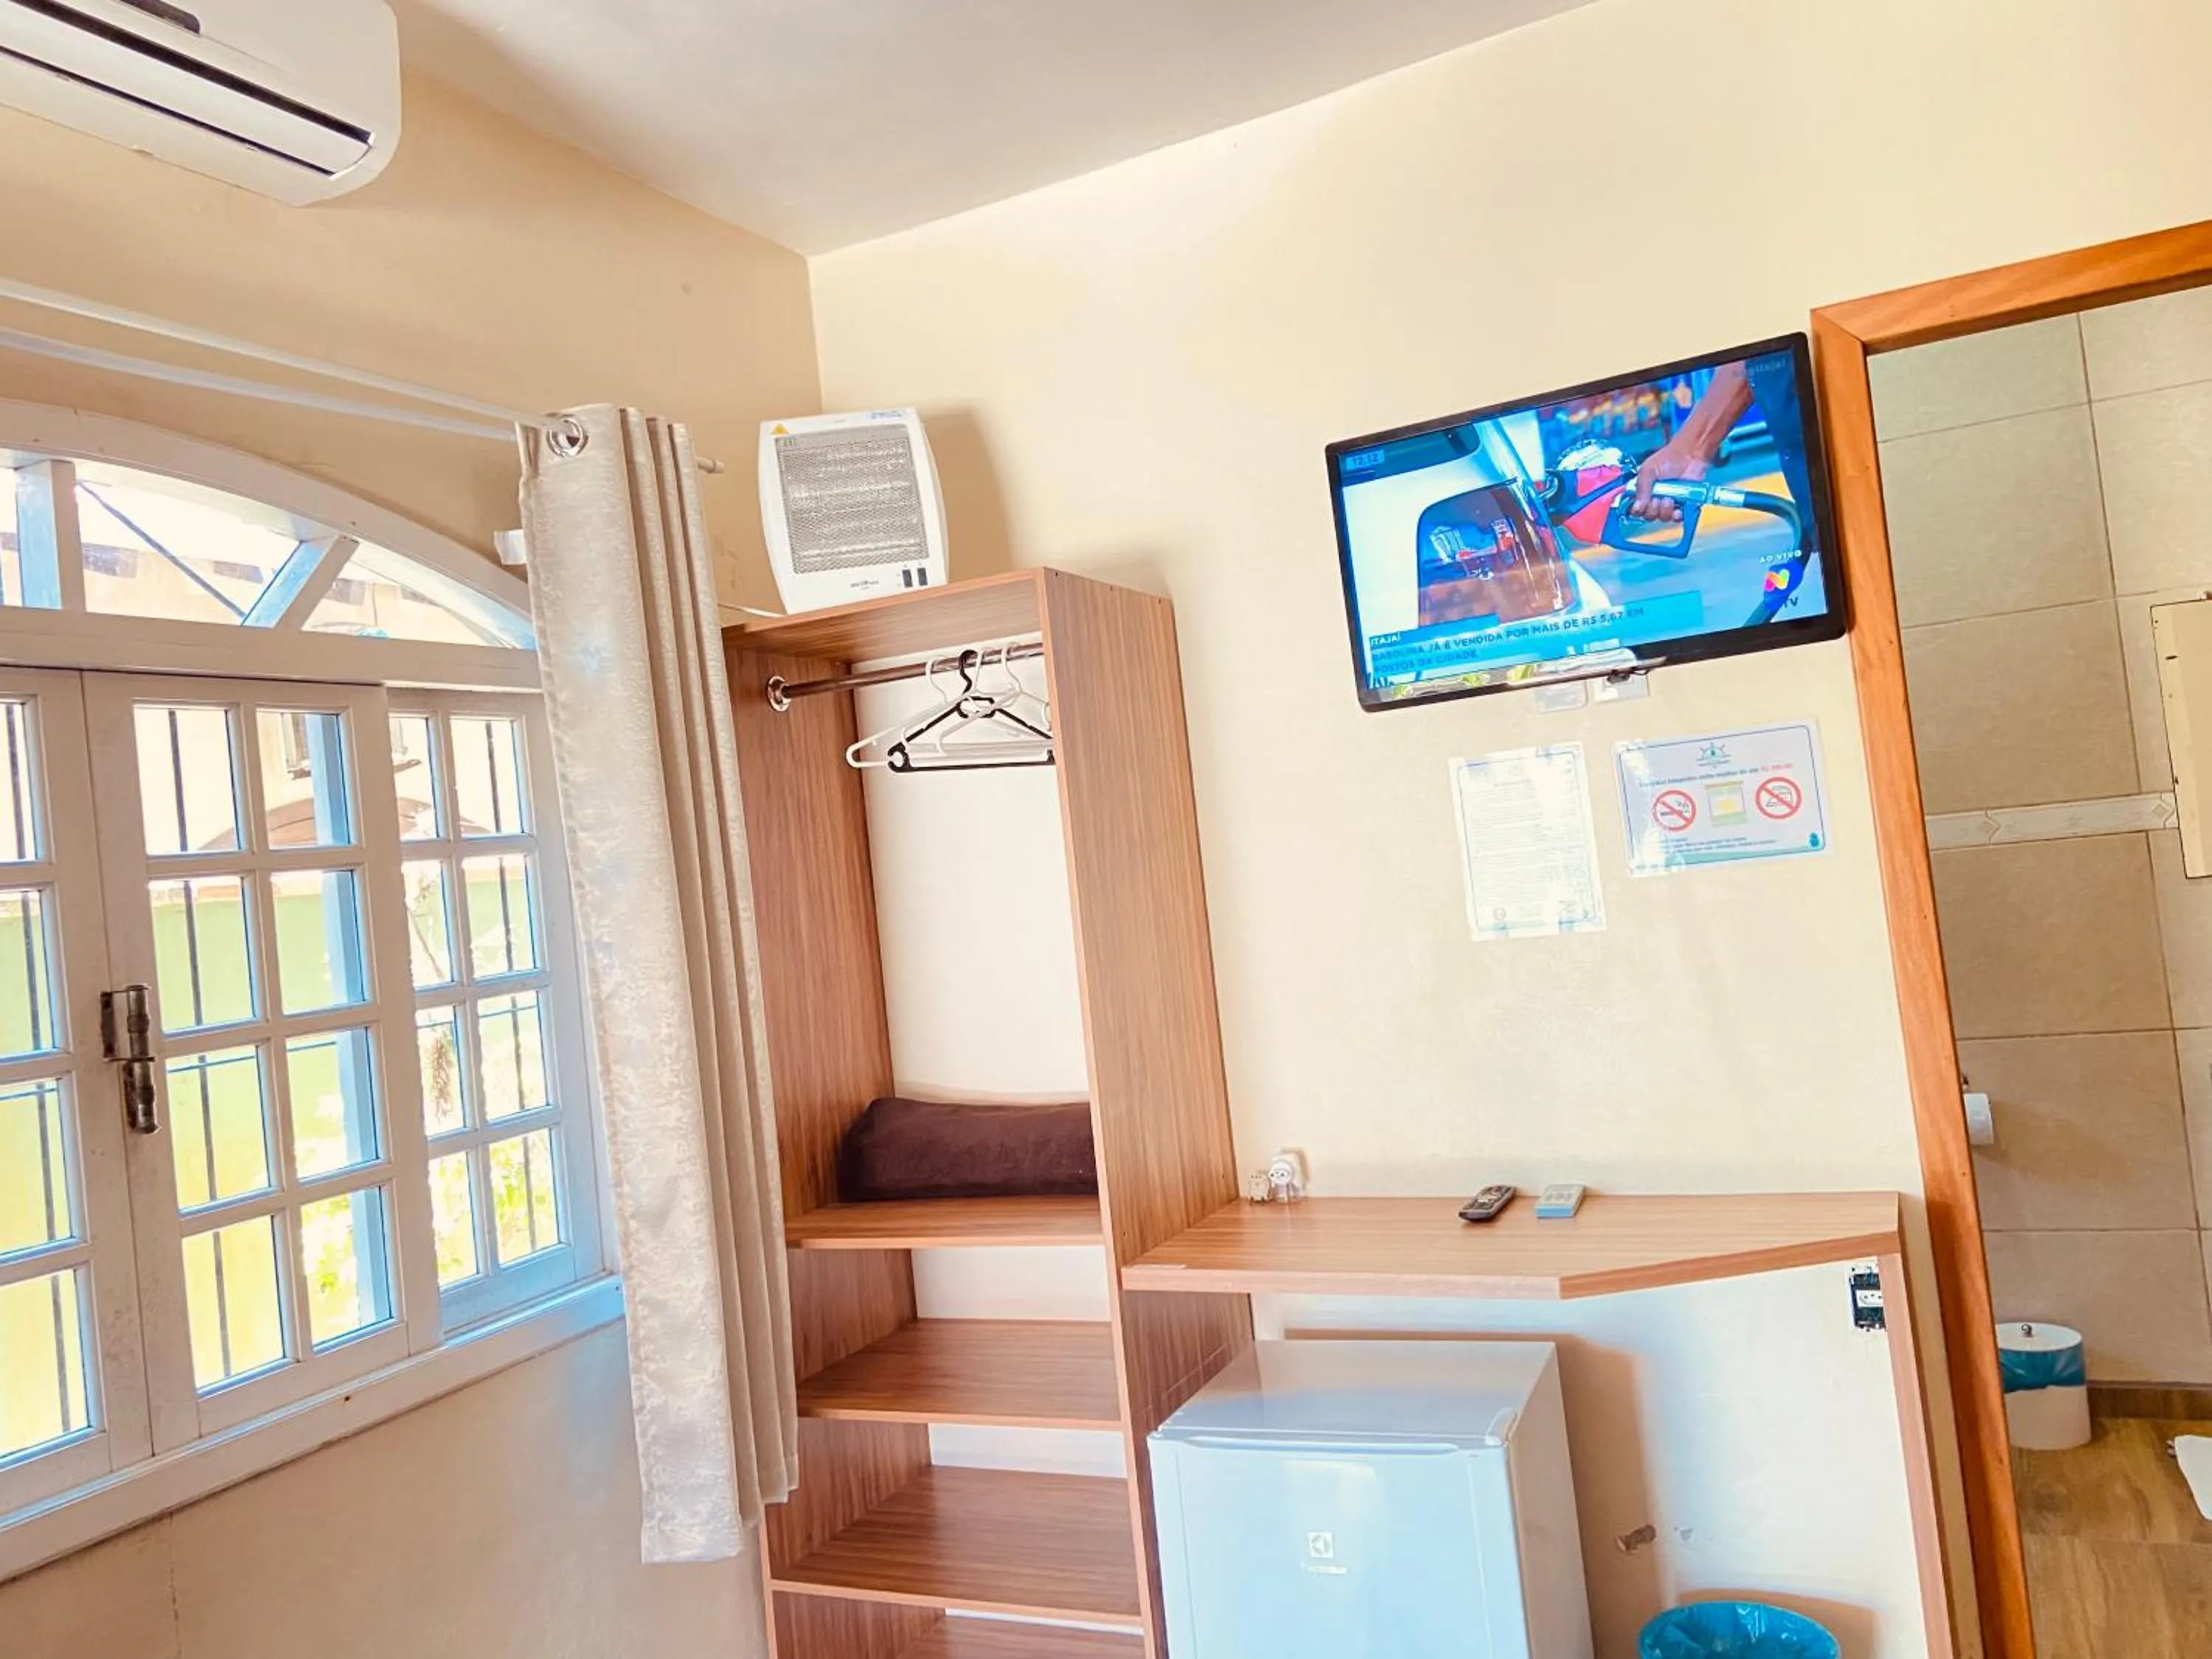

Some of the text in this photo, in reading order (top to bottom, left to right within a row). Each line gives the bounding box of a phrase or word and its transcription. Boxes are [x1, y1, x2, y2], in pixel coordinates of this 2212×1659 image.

[1453, 633, 1503, 648] VENDIDA
[1506, 627, 1528, 639] POR
[1531, 622, 1560, 635] MAIS
[1563, 618, 1579, 630] DE
[1435, 649, 1478, 664] CIDADE
